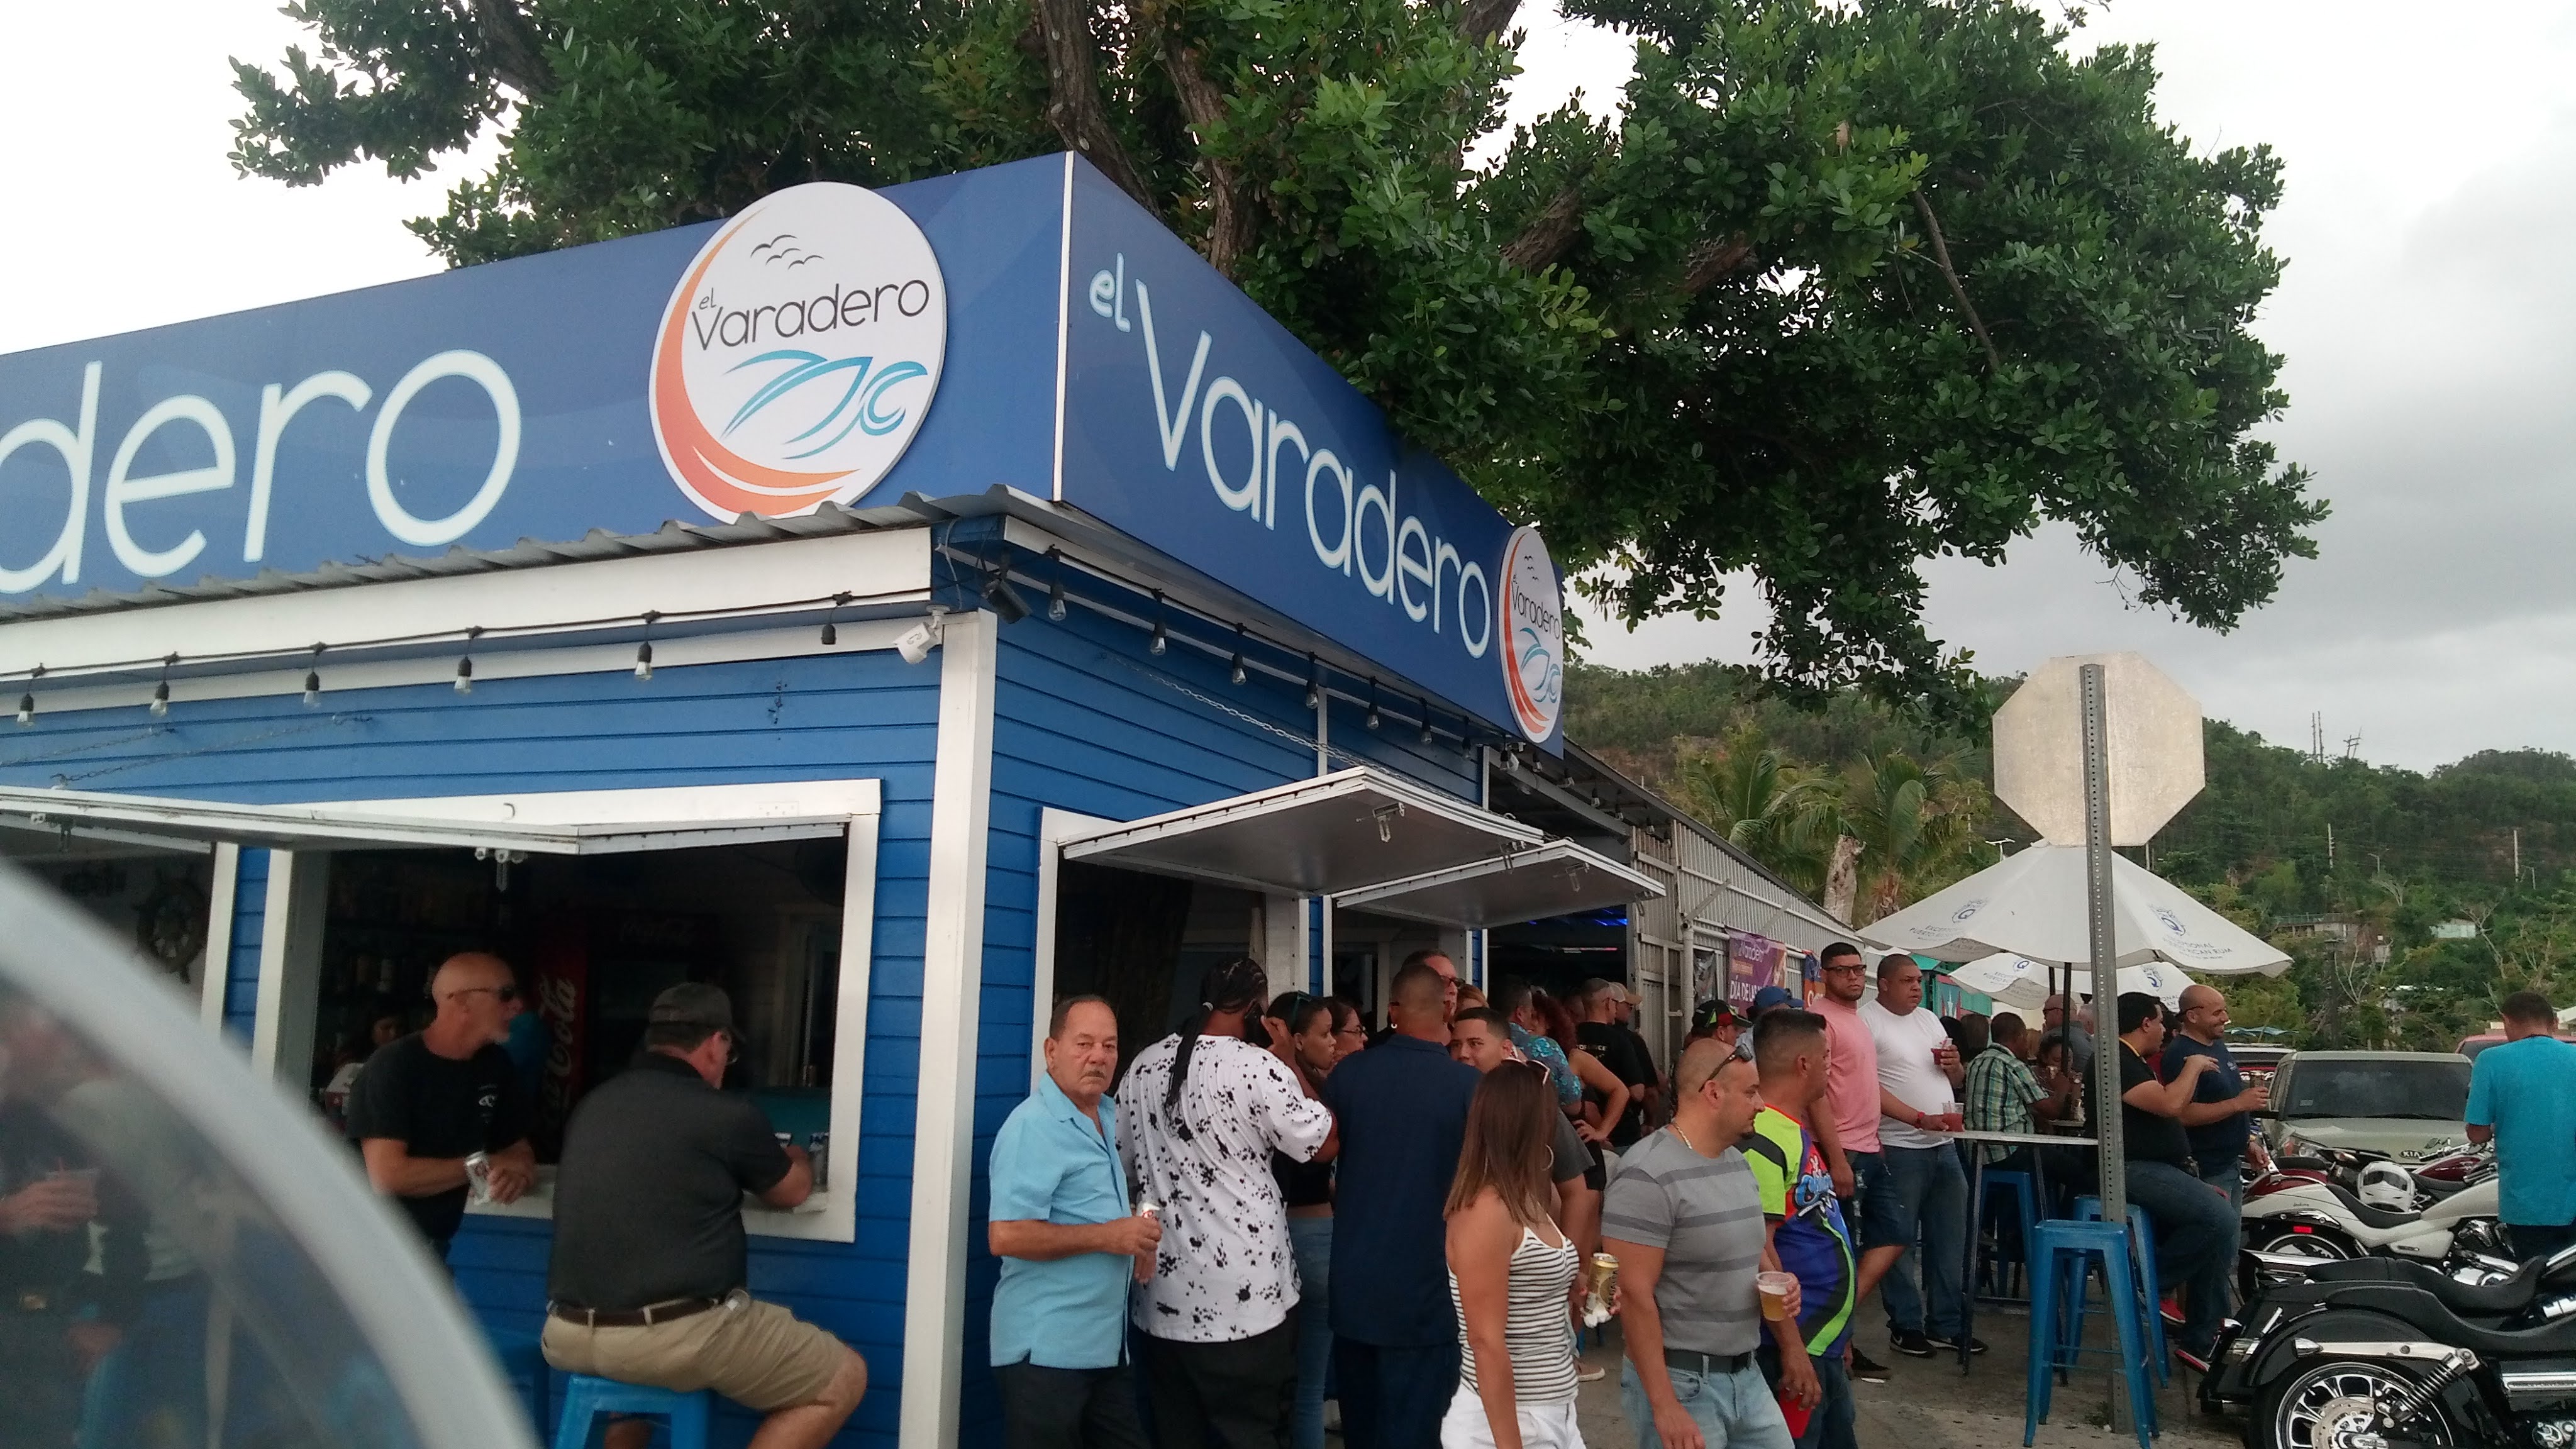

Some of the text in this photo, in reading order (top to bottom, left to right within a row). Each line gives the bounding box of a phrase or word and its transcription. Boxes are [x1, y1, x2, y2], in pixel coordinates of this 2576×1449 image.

[692, 280, 930, 351] el Varadero
[1089, 252, 1492, 659] el Varadero
[1511, 581, 1560, 640] Varadero
